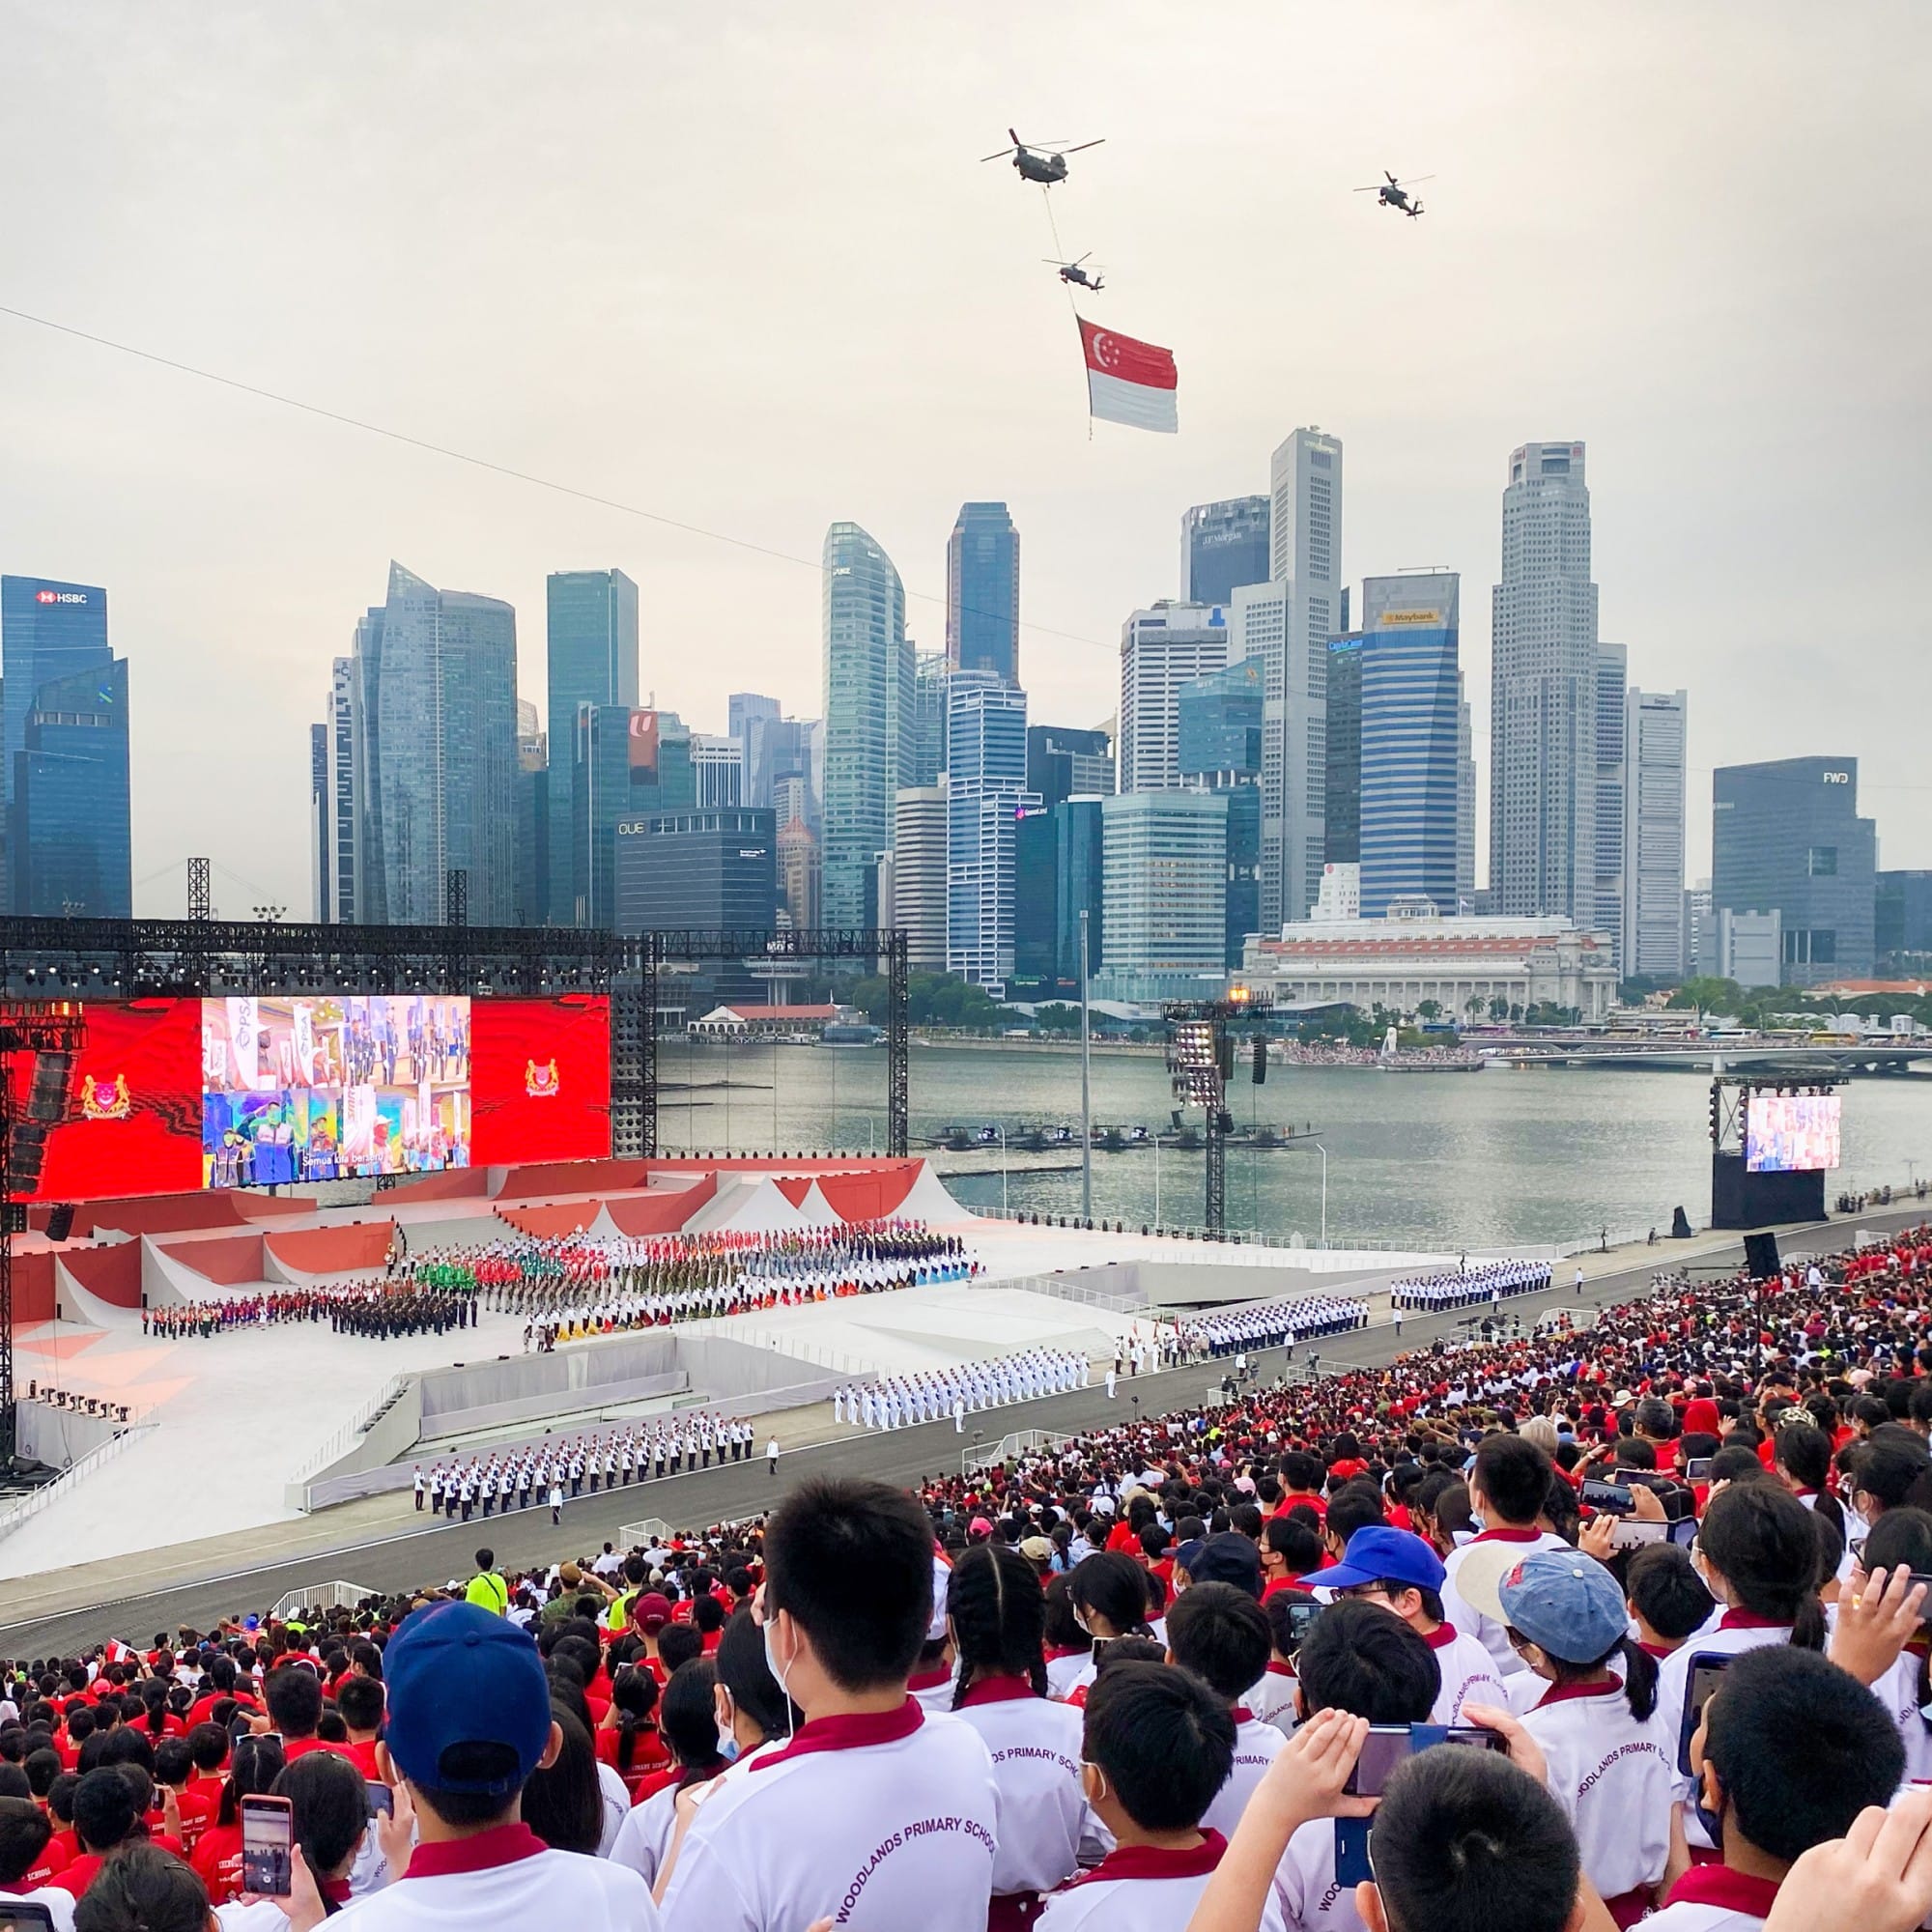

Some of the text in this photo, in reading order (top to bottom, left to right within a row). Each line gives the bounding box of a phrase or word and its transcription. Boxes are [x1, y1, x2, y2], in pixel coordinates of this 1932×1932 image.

[57, 592, 88, 604] HSBC
[1394, 611, 1435, 621] Maybank
[1824, 772, 1849, 784] FWD
[618, 822, 645, 836] OUE
[302, 1154, 332, 1167] Semua
[1007, 1747, 1057, 1761] PRIMARY
[1619, 1742, 1658, 1757] PRIMARY
[1234, 1754, 1270, 1767] RIMARY
[373, 1857, 388, 1878] WOO
[836, 1833, 903, 1924] WOODLANDS
[903, 1817, 963, 1841] PRIMARY
[1319, 1882, 1343, 1912] WOO
